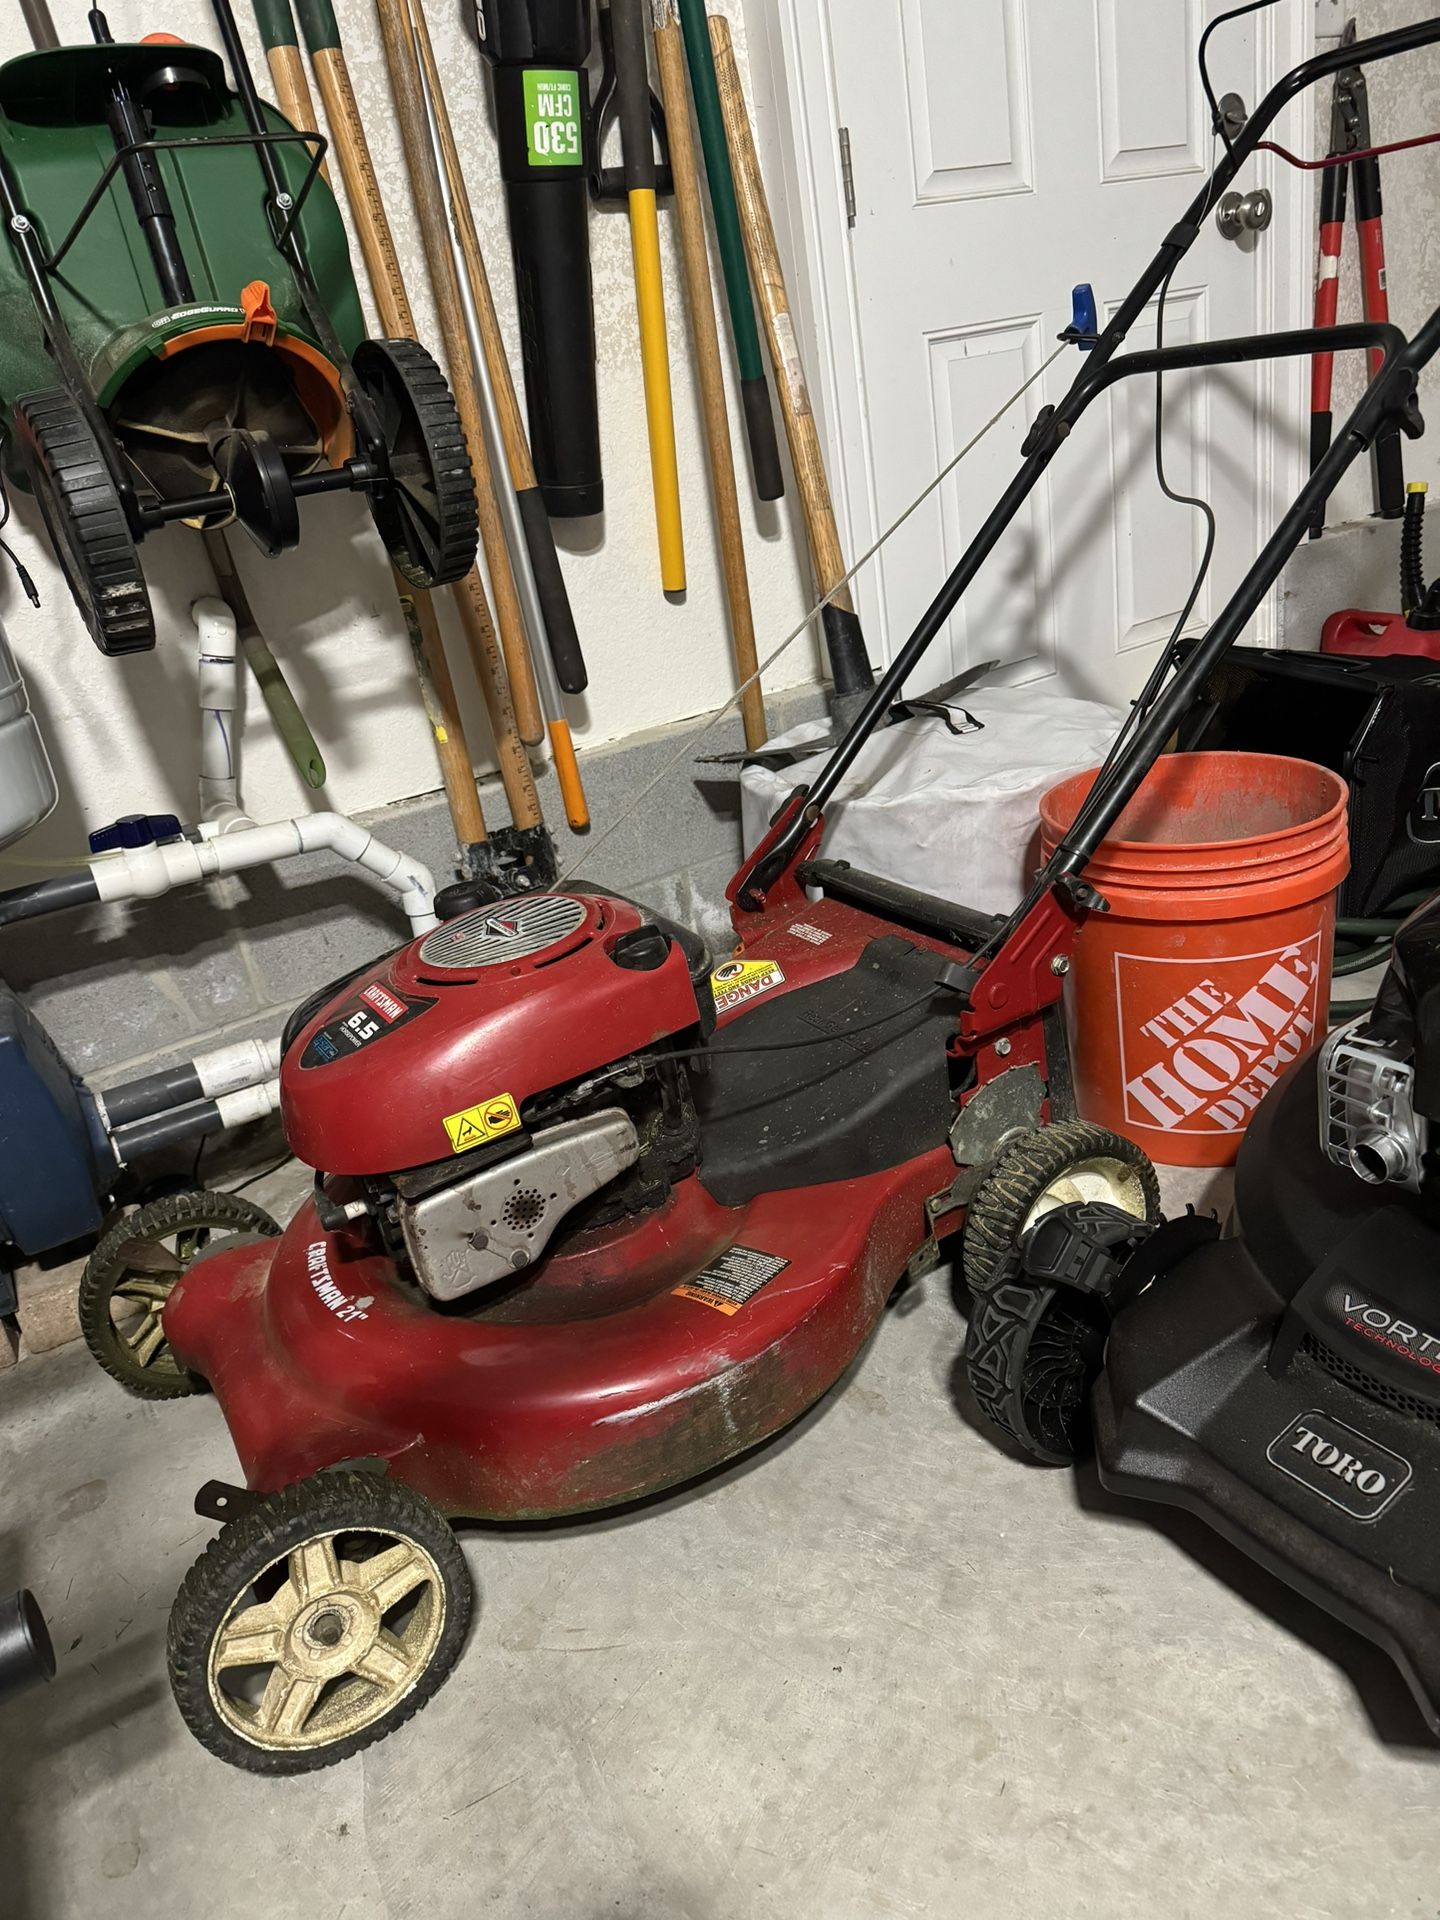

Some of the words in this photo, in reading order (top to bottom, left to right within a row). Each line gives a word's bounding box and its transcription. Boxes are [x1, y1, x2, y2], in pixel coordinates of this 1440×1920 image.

[533, 121, 578, 154] 530
[537, 94, 572, 117] CFM
[363, 984, 404, 1019] CRAFTSMAN
[715, 975, 773, 1009] DANGE
[1139, 979, 1233, 1049] THE
[347, 1011, 380, 1040] 6.5
[1126, 946, 1319, 1129] HOME
[1203, 1005, 1314, 1131] DEPOT
[307, 1241, 348, 1311] CRAFTSMAN
[1344, 1294, 1440, 1360] VORT
[1292, 1426, 1386, 1494] TORO
